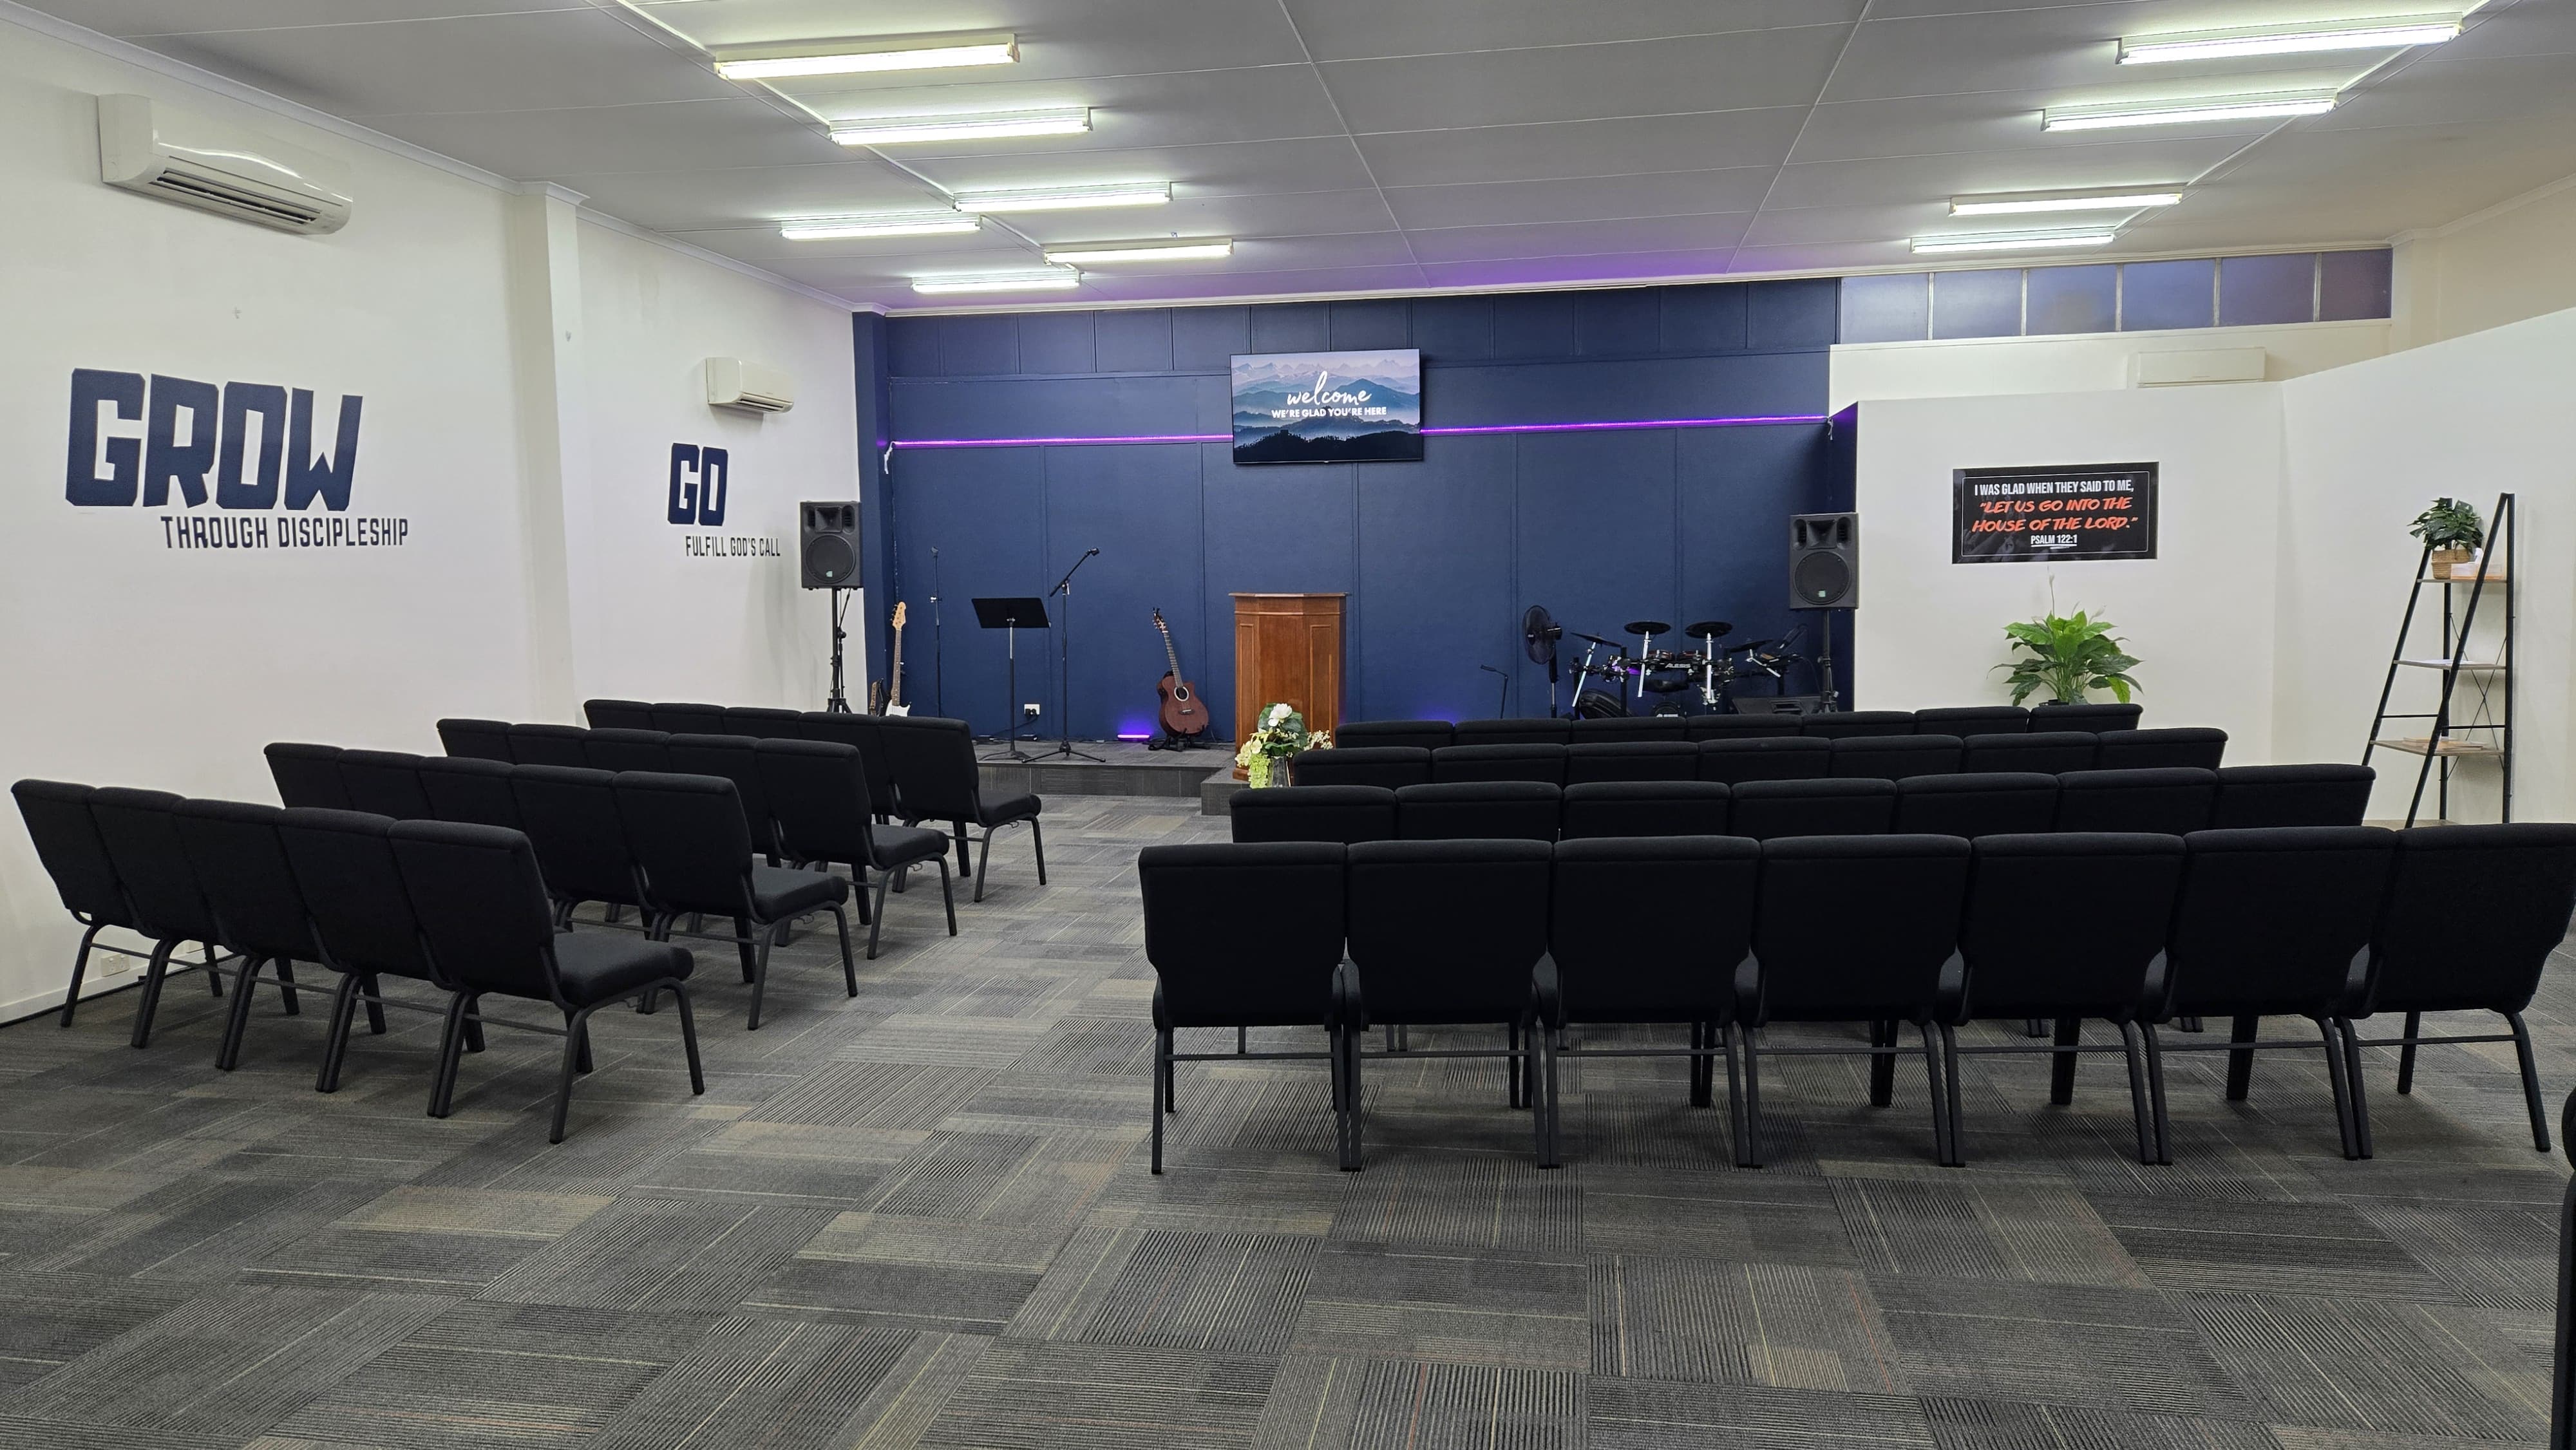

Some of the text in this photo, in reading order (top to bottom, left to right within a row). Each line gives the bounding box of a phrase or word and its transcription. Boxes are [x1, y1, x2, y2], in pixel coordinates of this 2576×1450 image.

[1287, 370, 1372, 406] welcome
[1271, 406, 1387, 419] WE'RE GLAD YOU'RE HERE
[65, 368, 363, 512] GROW
[667, 442, 728, 527] GO
[1975, 480, 2134, 496] I WAS GLAD WHEN THEY SAID TO ME,
[2014, 500, 2035, 513] US
[2038, 500, 2063, 512] GO
[2065, 498, 2100, 511] INTO
[2103, 496, 2133, 510] THE
[160, 516, 409, 549] THROUGH DISCIPLESHIP
[1971, 519, 2026, 532] HOUSE
[2029, 518, 2052, 531] OF
[2053, 518, 2081, 531] THE
[685, 536, 781, 557] FULFILL GOD'S CALL
[2030, 534, 2078, 545] PSALM 122:1
